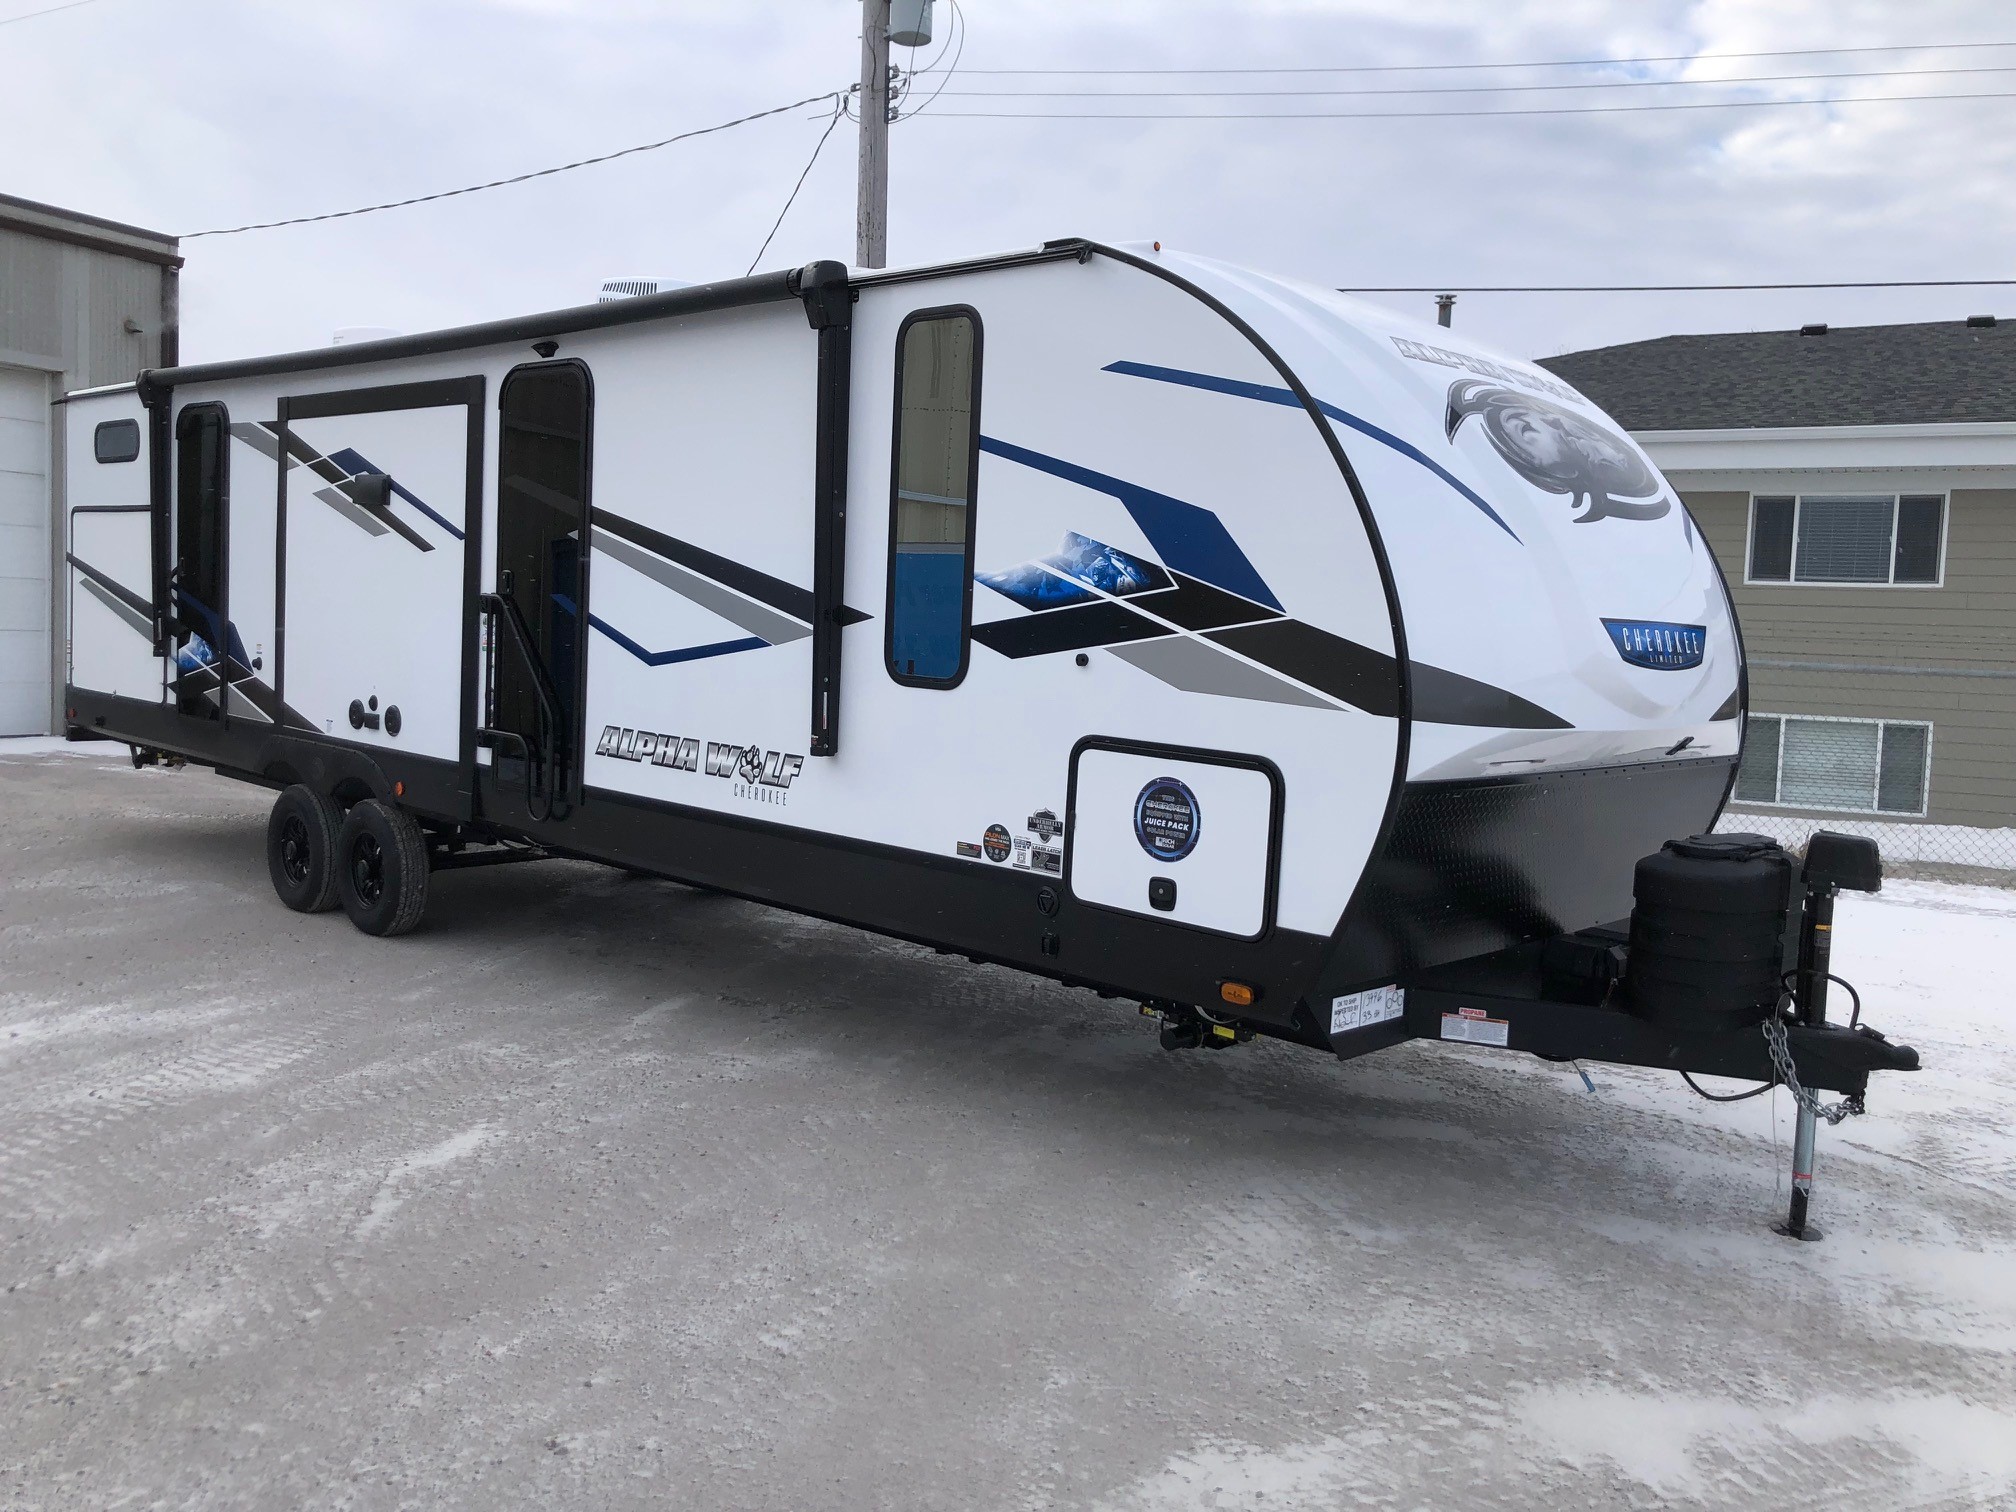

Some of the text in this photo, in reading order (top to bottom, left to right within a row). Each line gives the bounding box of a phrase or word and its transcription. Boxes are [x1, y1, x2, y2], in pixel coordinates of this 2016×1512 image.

[1622, 627, 1699, 655] CHEROKEE
[1649, 654, 1683, 664] LIMITED
[594, 724, 701, 773] ALPHA
[733, 783, 787, 806] CHEROKEE
[1144, 817, 1190, 831] JUICE PACK
[1460, 1008, 1485, 1016] PROPANE
